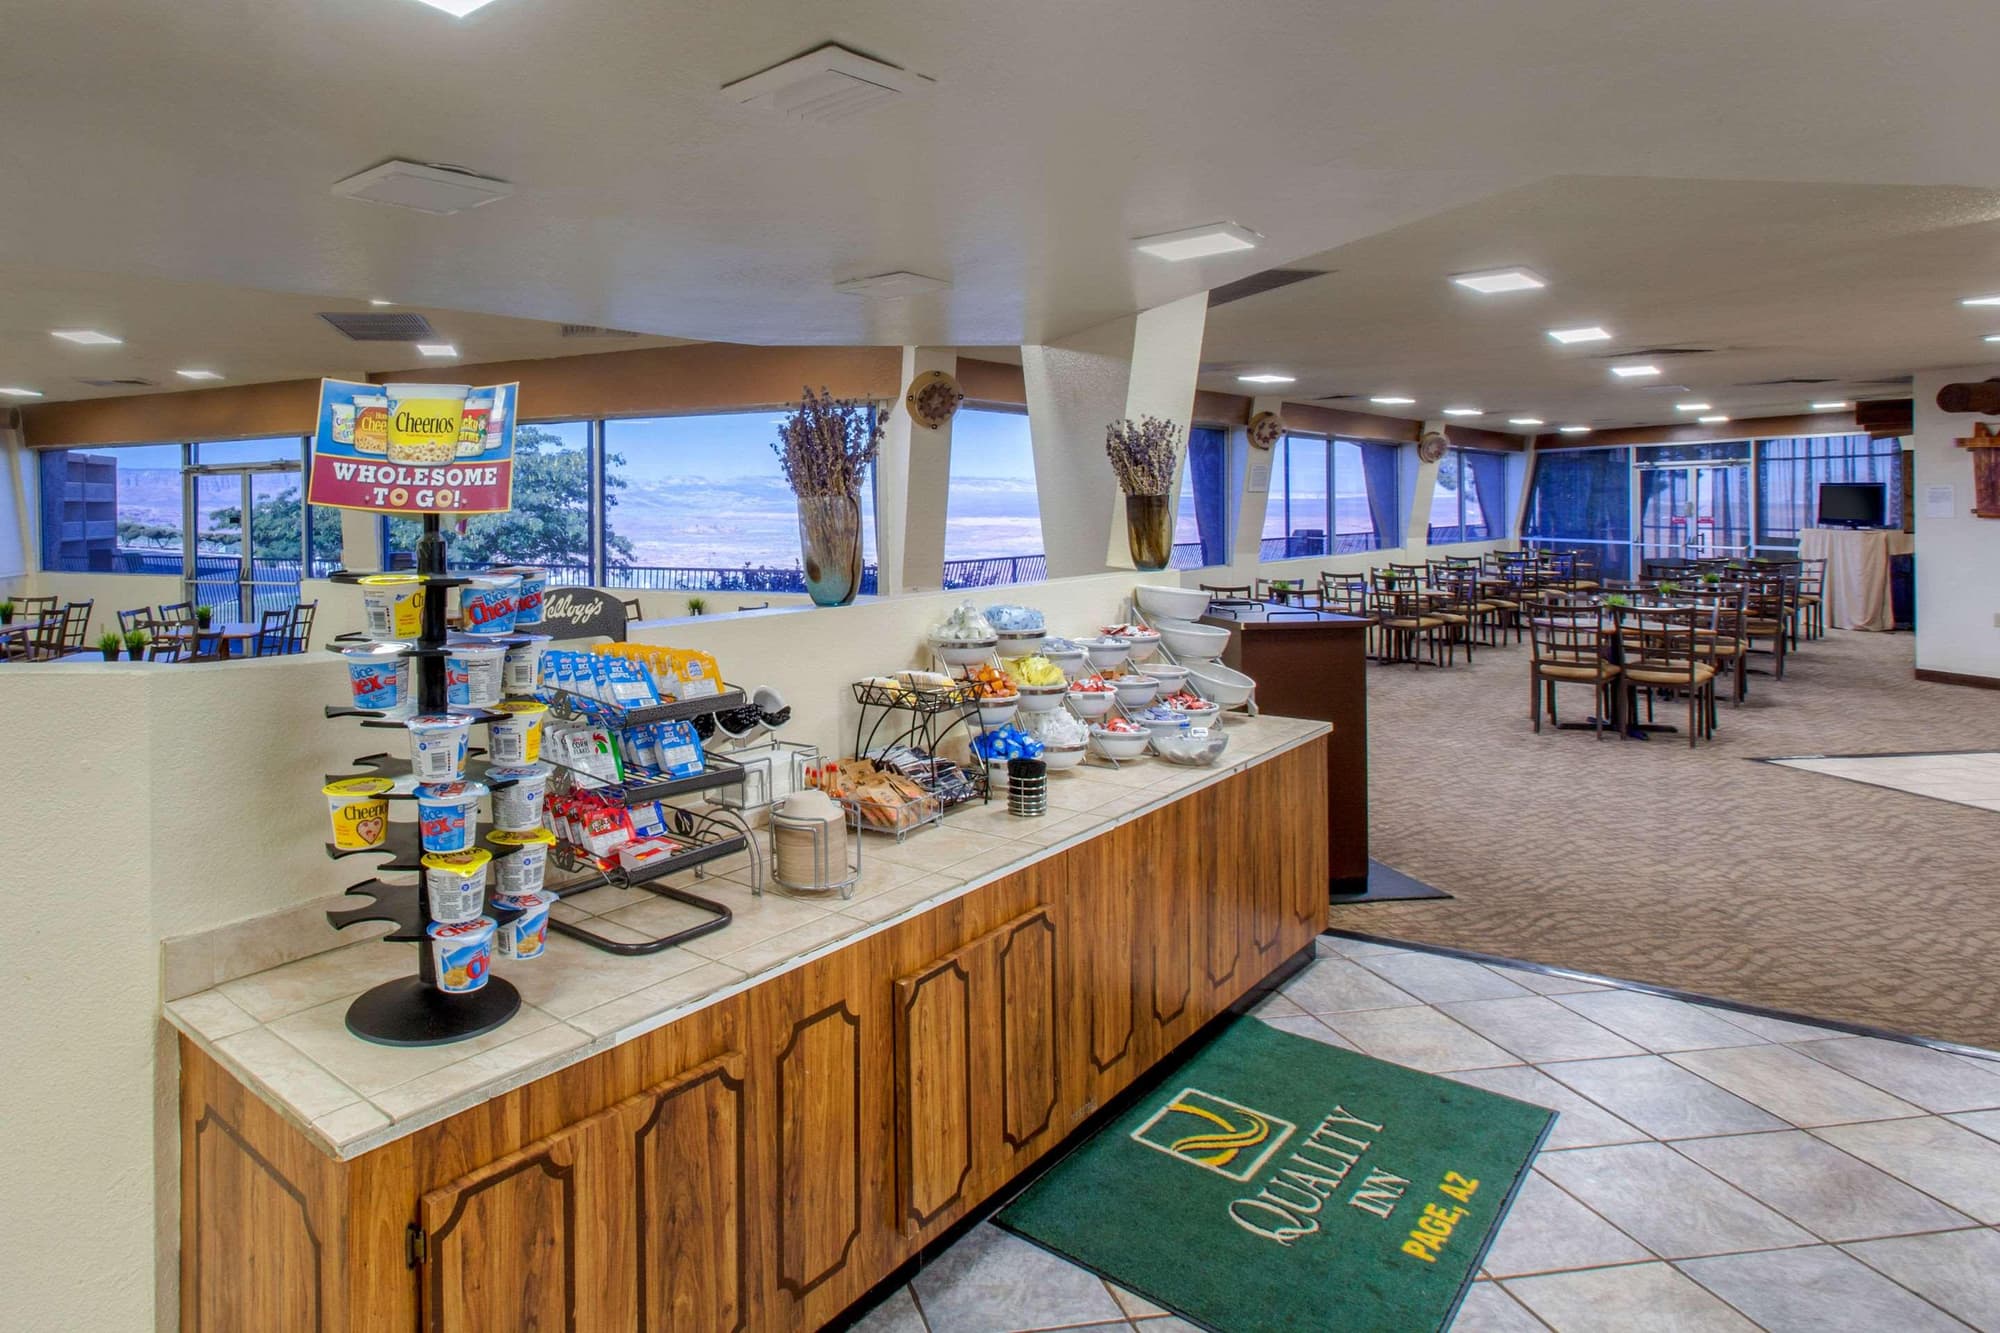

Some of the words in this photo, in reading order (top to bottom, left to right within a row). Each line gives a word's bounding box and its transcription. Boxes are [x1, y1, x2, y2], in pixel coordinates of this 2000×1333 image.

[396, 411, 454, 434] Cheerios
[332, 461, 498, 486] WHOLESOME
[373, 487, 409, 507] TO
[415, 489, 461, 508] GO!
[469, 597, 514, 625] Chex
[483, 590, 508, 606] Rice
[543, 594, 604, 625] Kellogg's
[1229, 1105, 1384, 1247] QUALITY
[1349, 1166, 1412, 1219] INN
[1402, 1203, 1470, 1263] PAGE,
[1439, 1171, 1480, 1203] AZ
